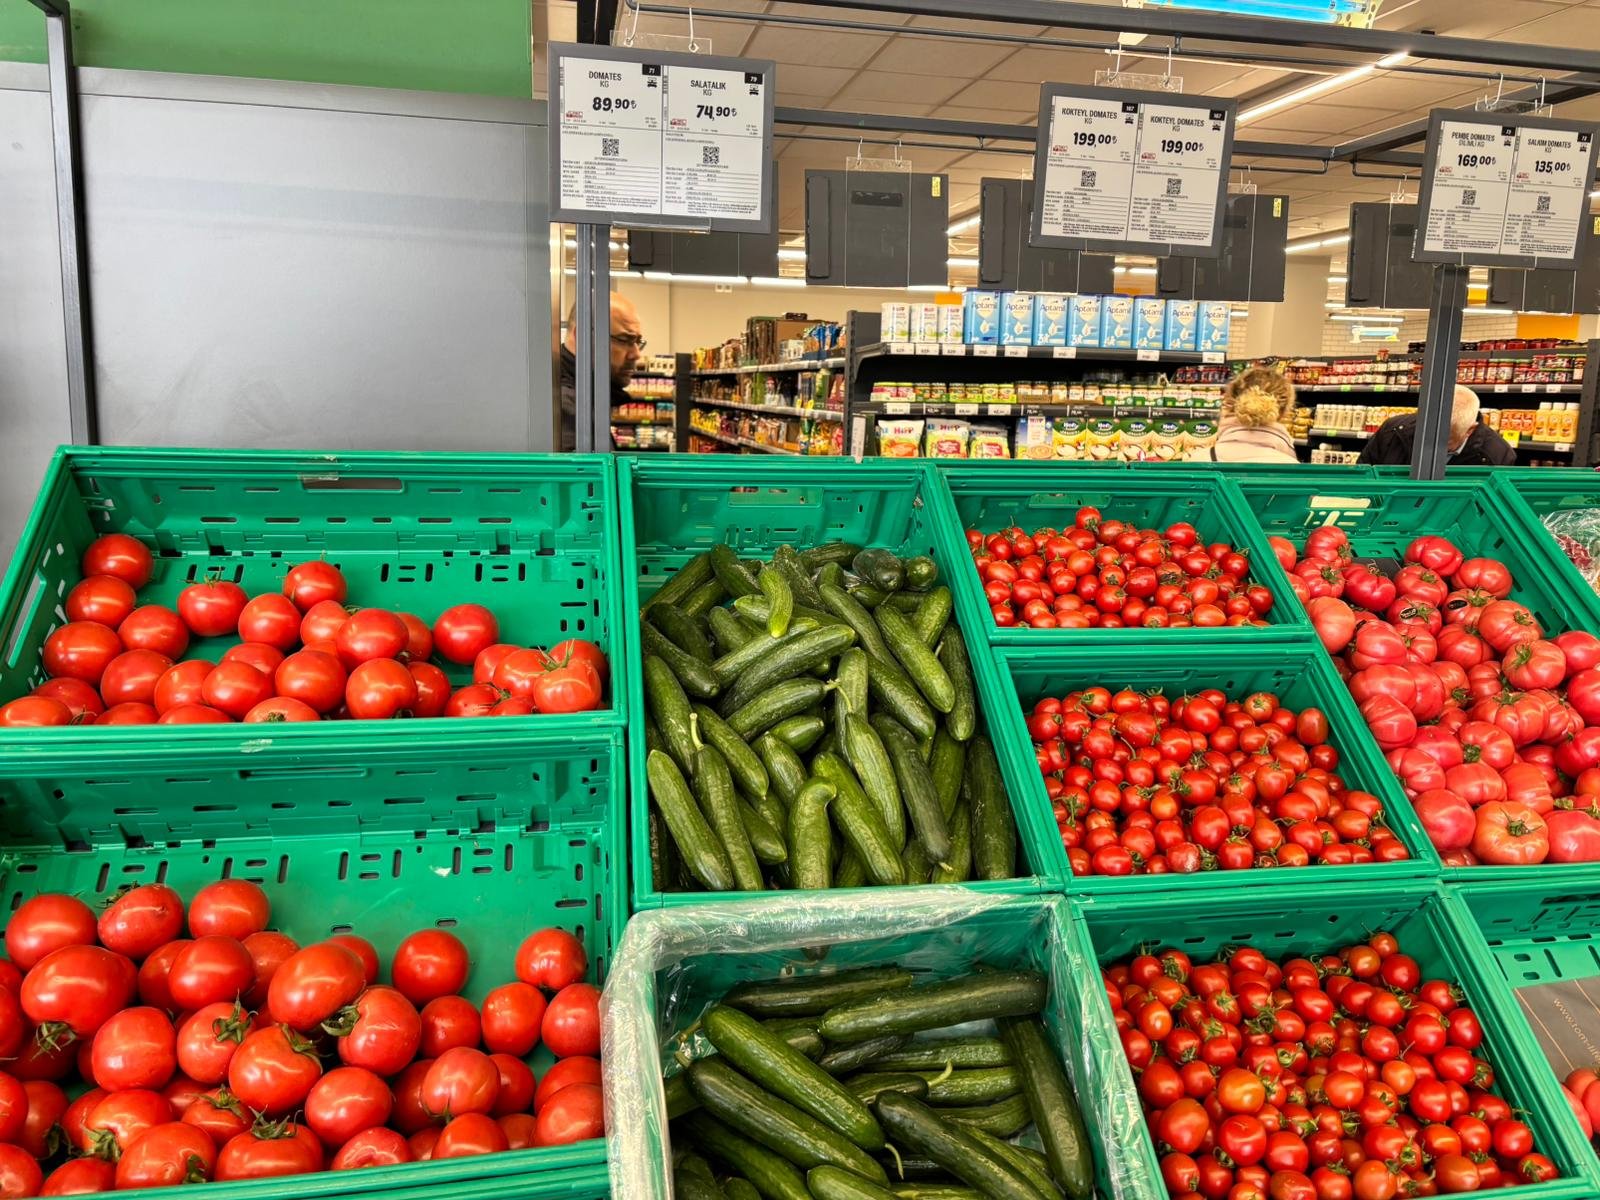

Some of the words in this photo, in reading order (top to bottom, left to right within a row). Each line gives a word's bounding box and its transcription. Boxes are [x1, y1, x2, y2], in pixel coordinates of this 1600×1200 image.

[588, 70, 623, 82] DOMATES
[599, 80, 610, 89] KG
[690, 79, 727, 91] SALATALIK
[702, 89, 713, 97] KG
[1061, 107, 1088, 118] KOKTEYL
[1089, 109, 1118, 120] DOMATES
[1083, 117, 1093, 125] KG
[1150, 115, 1177, 126] KOKTEYL
[1177, 117, 1205, 128] DOMATES
[1172, 125, 1181, 133] KG
[1451, 131, 1470, 141] PEMBE
[1470, 132, 1495, 142] DOMATES
[1547, 139, 1572, 149] DOMATES
[1005, 302, 1031, 312] Aptamil
[1040, 303, 1066, 312] Aptamil
[1073, 304, 1099, 313] Aptamil
[1106, 305, 1131, 314] Aptamil
[1139, 307, 1163, 316] Aptamil
[1172, 308, 1196, 317] Aptamil
[1205, 310, 1228, 319] Aptamil
